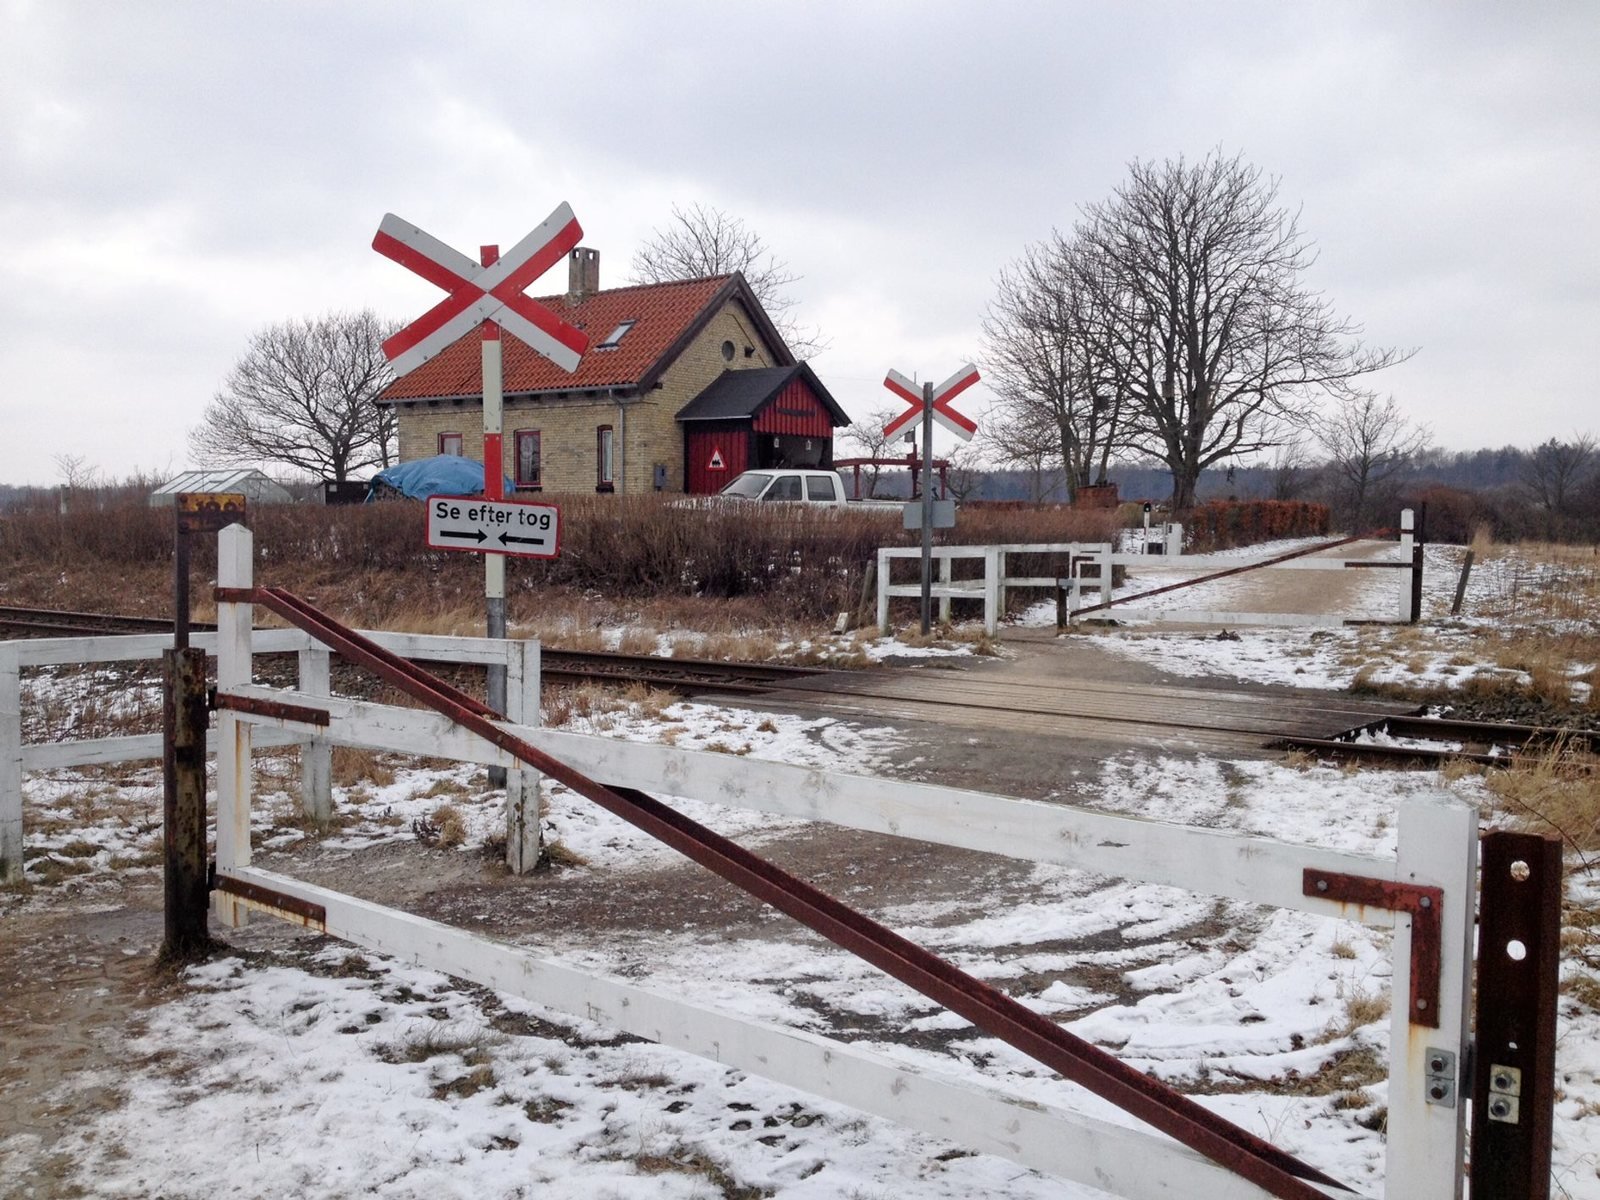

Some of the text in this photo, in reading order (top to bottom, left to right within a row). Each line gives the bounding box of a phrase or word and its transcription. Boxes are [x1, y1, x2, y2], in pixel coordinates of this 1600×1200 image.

[436, 502, 551, 530] Se efter tog
